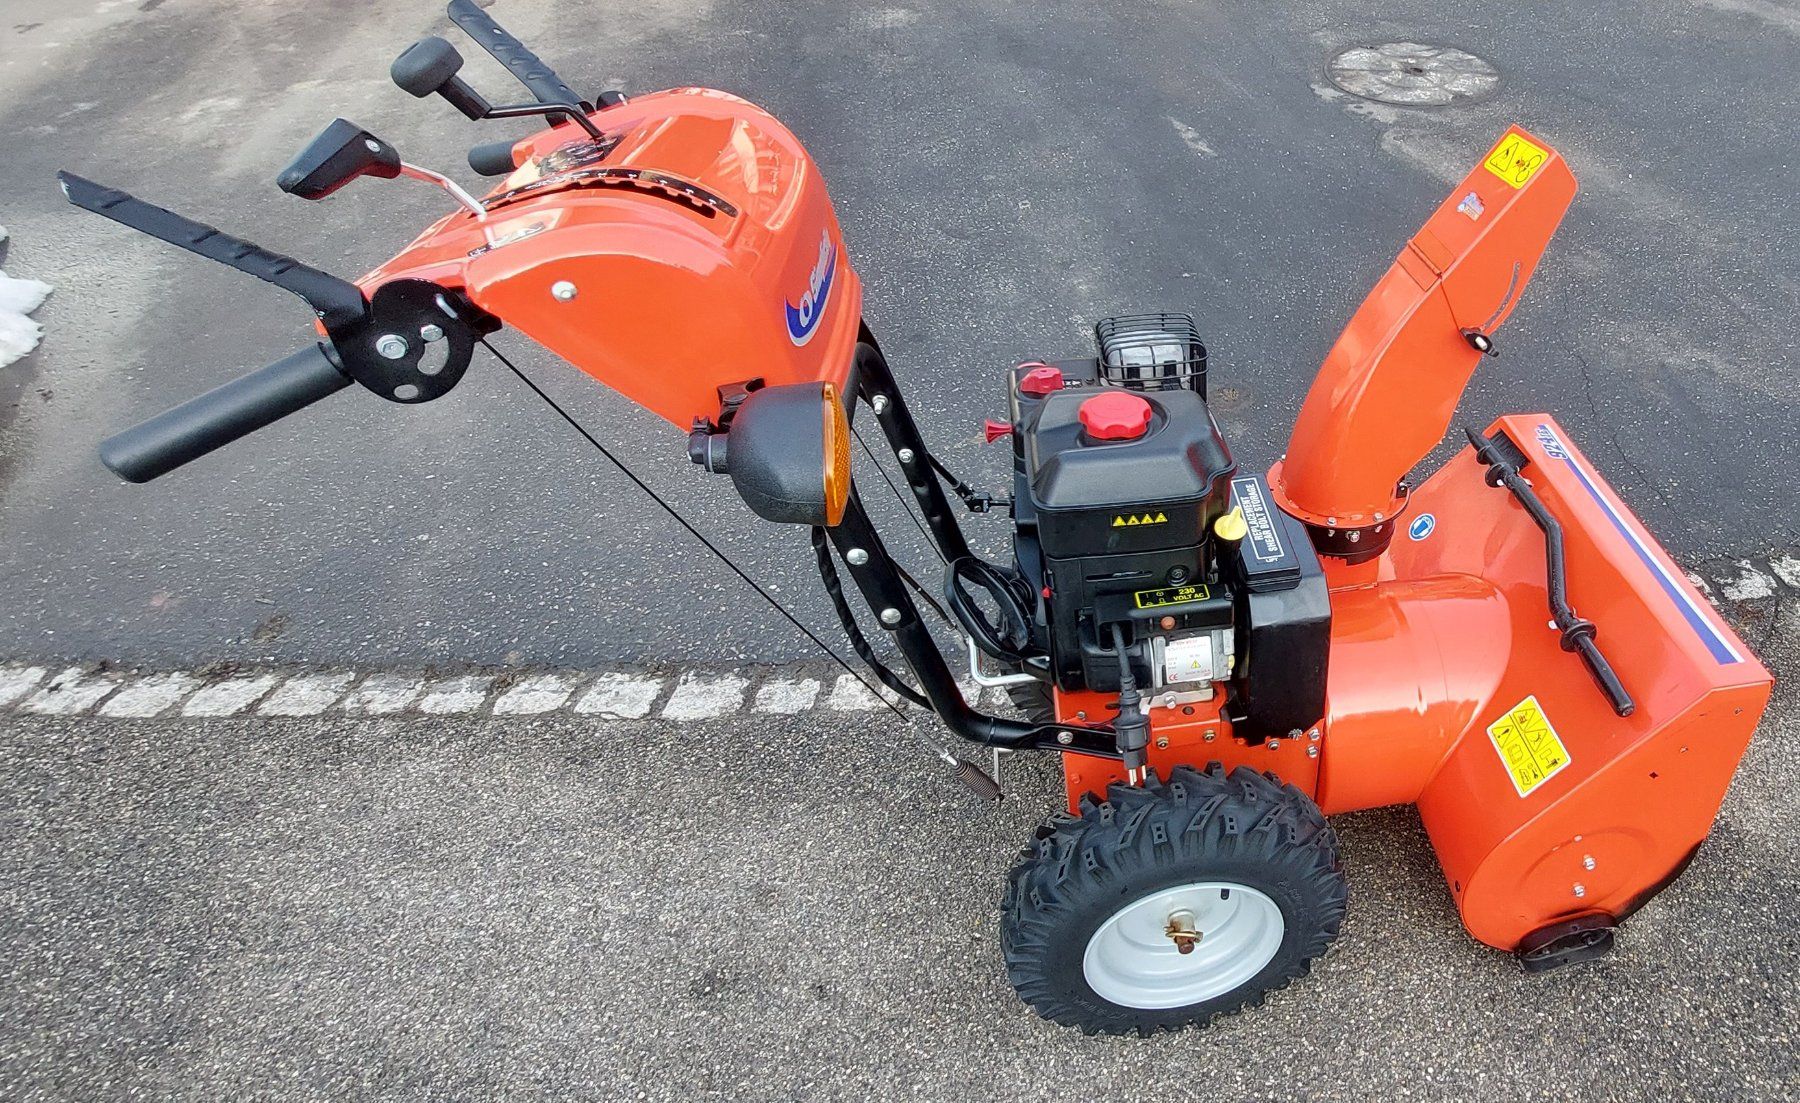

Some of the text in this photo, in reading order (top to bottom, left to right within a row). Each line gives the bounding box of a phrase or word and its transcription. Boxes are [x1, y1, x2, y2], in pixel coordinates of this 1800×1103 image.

[1240, 496, 1264, 541] REPLACEMENT
[1245, 483, 1278, 552] SHEAR BOLT STORAGE
[1178, 587, 1196, 595] 230
